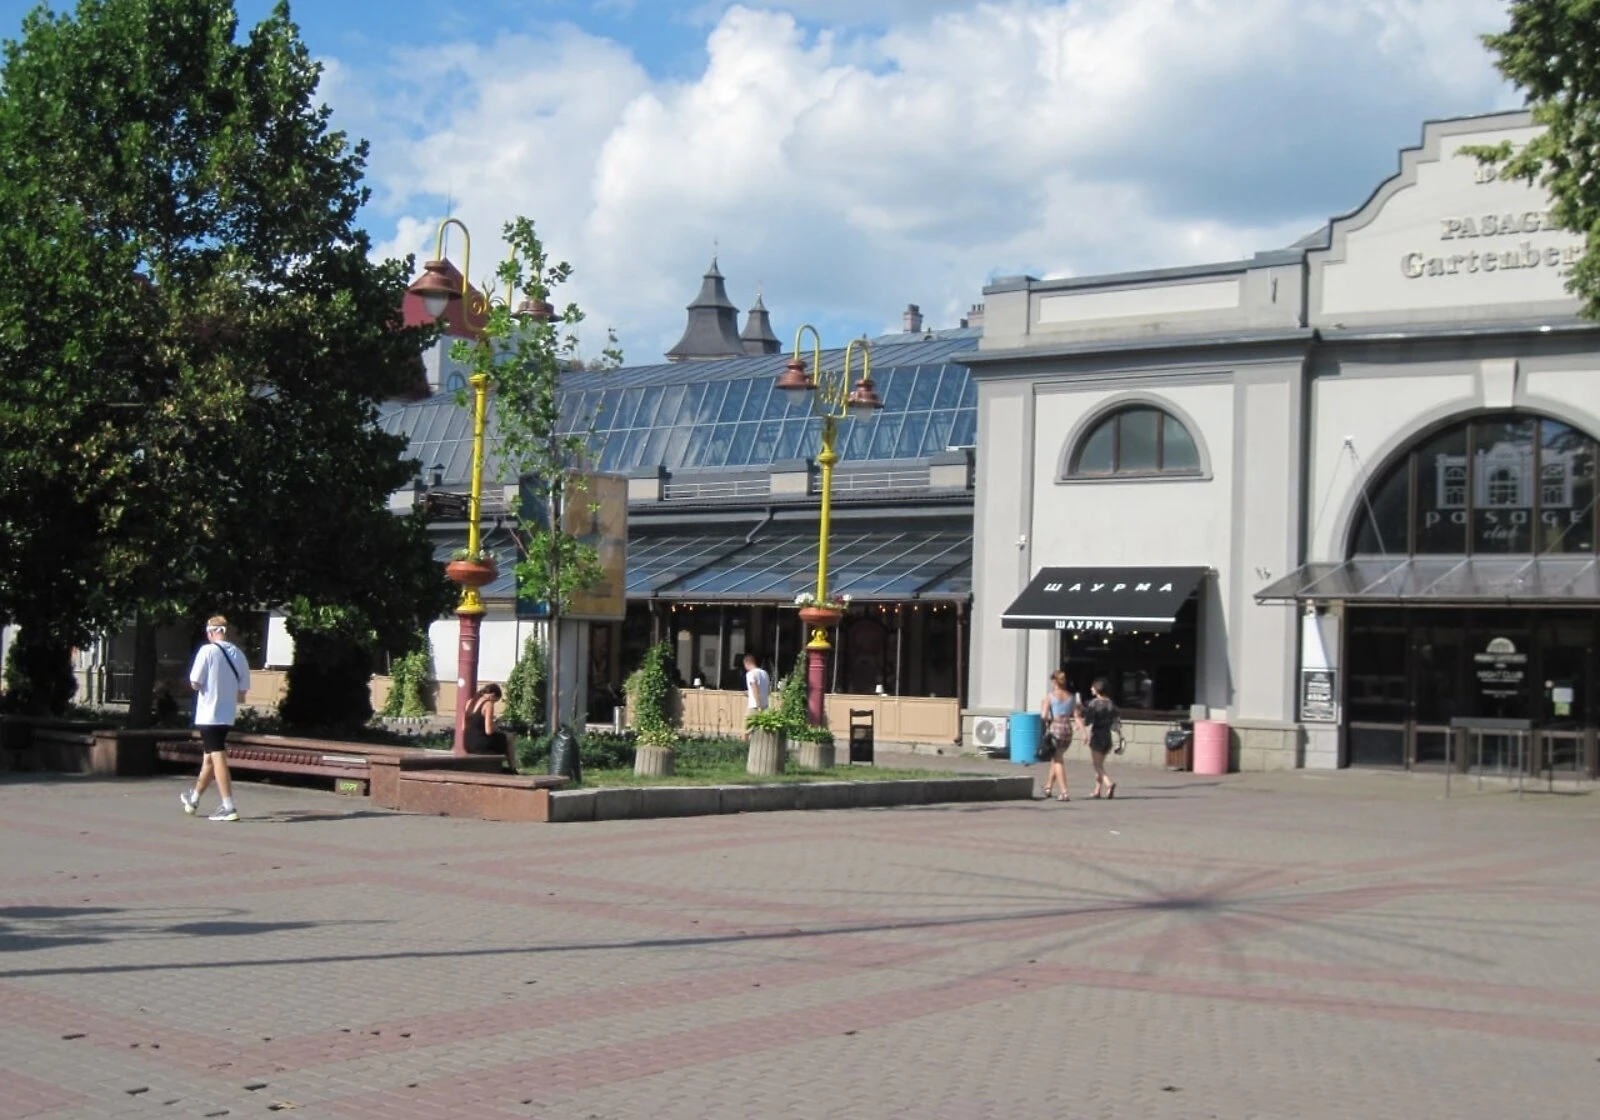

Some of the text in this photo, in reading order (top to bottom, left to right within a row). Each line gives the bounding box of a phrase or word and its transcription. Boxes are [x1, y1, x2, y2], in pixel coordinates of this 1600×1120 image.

[1400, 240, 1588, 279] Gartenber
[1043, 582, 1173, 592] ШАУРМА
[1055, 619, 1114, 631] ШАУРМА
